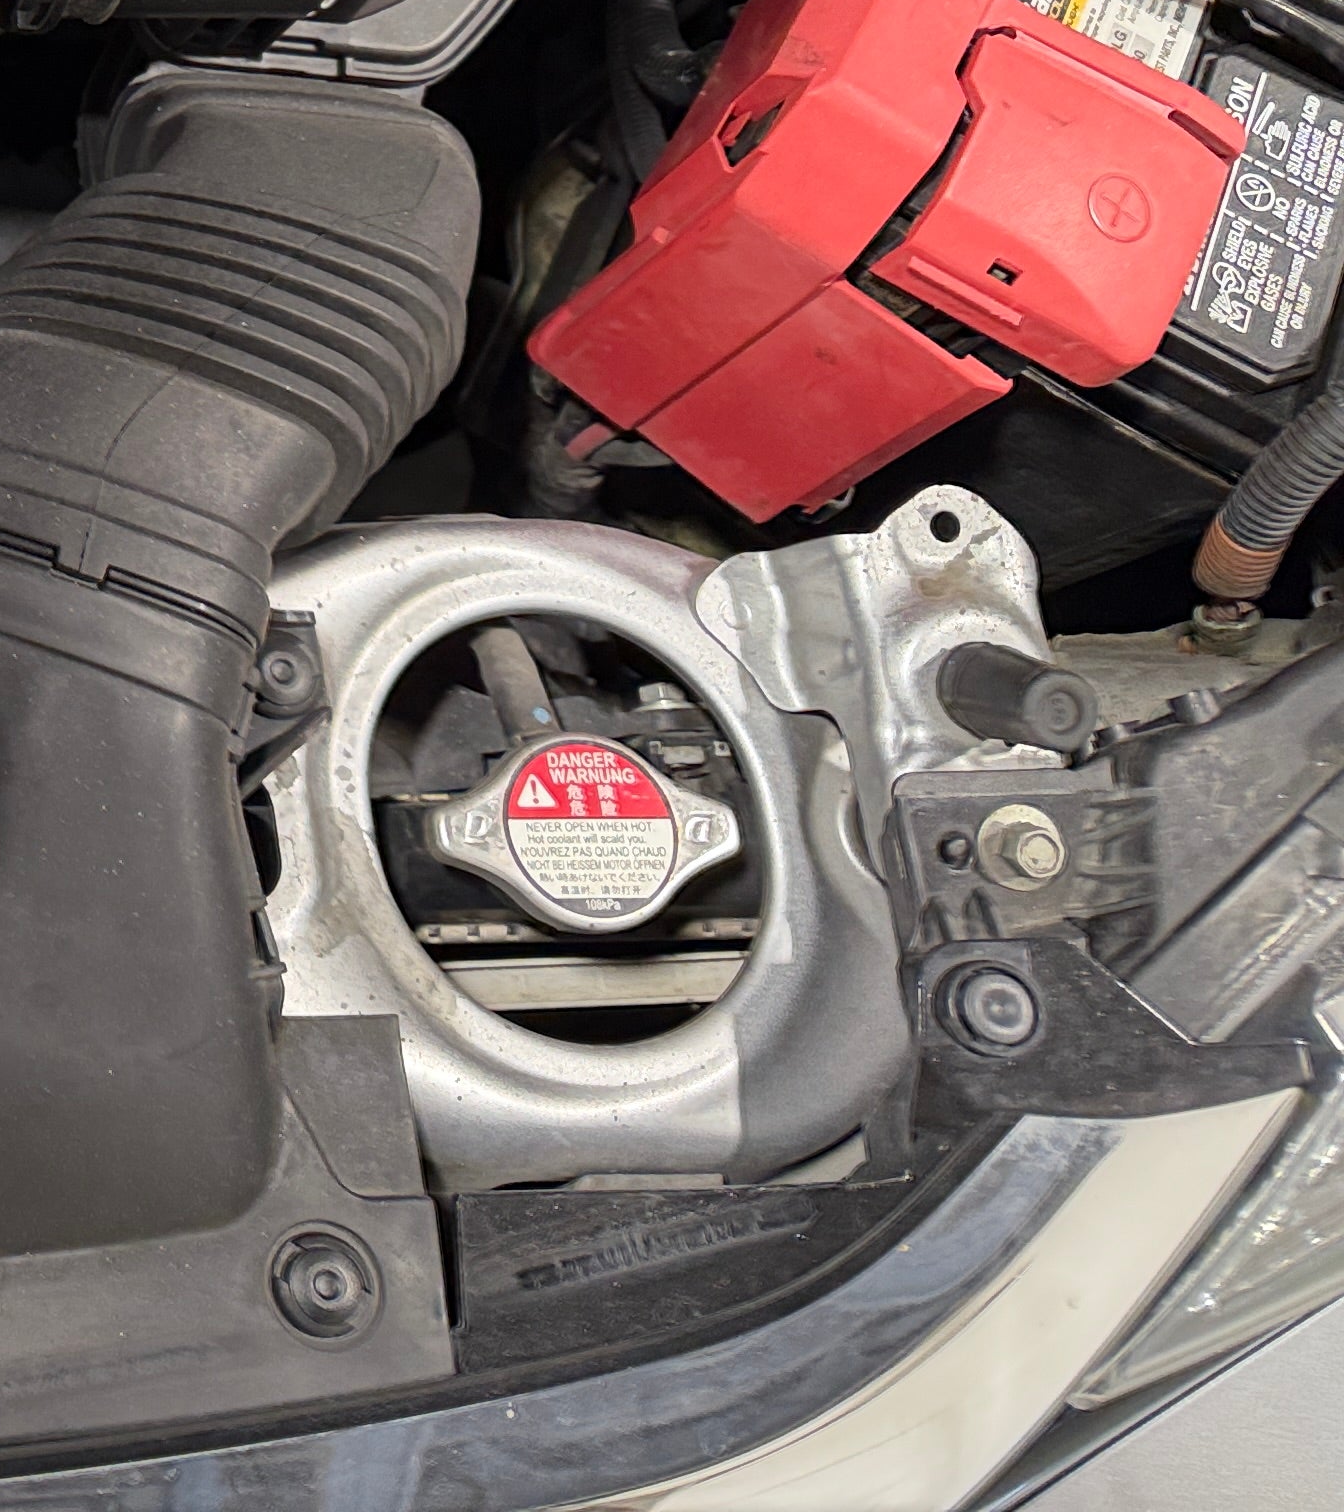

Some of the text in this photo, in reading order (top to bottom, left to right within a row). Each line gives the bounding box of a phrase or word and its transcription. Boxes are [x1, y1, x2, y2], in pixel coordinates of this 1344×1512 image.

[1110, 29, 1128, 50] LG
[1286, 95, 1320, 176] SULFURIC ACID
[1328, 120, 1343, 136] OR
[1301, 128, 1326, 182] CAN CAUSE
[1272, 197, 1290, 220] NO
[1286, 198, 1306, 236] SPARKS
[1298, 204, 1319, 243] FLAMES
[1222, 221, 1248, 262] SHIELD
[1312, 206, 1334, 249] SMOKING
[1237, 239, 1257, 270] EYES
[1244, 242, 1274, 305] EXPLOSIVE
[1261, 274, 1283, 312] GASES
[1290, 282, 1312, 329] OR INJURY
[1276, 299, 1293, 329] CAUSE
[1271, 328, 1285, 348] CAN
[546, 751, 616, 768] DANGER
[548, 768, 636, 785] WARNUNG
[525, 821, 562, 832] NEVER
[564, 821, 595, 832] OPEN
[597, 821, 629, 832] WHEN
[528, 834, 545, 844] Hot
[546, 834, 581, 844] coolant
[583, 834, 599, 844] will
[600, 834, 625, 844] scald
[520, 846, 667, 858] N'OUVREZ PAS QUAND CHAUD
[526, 860, 550, 870] NICHT
[552, 860, 565, 870] BEI
[567, 860, 602, 870] HEISSEM
[603, 860, 632, 870] MOTOR
